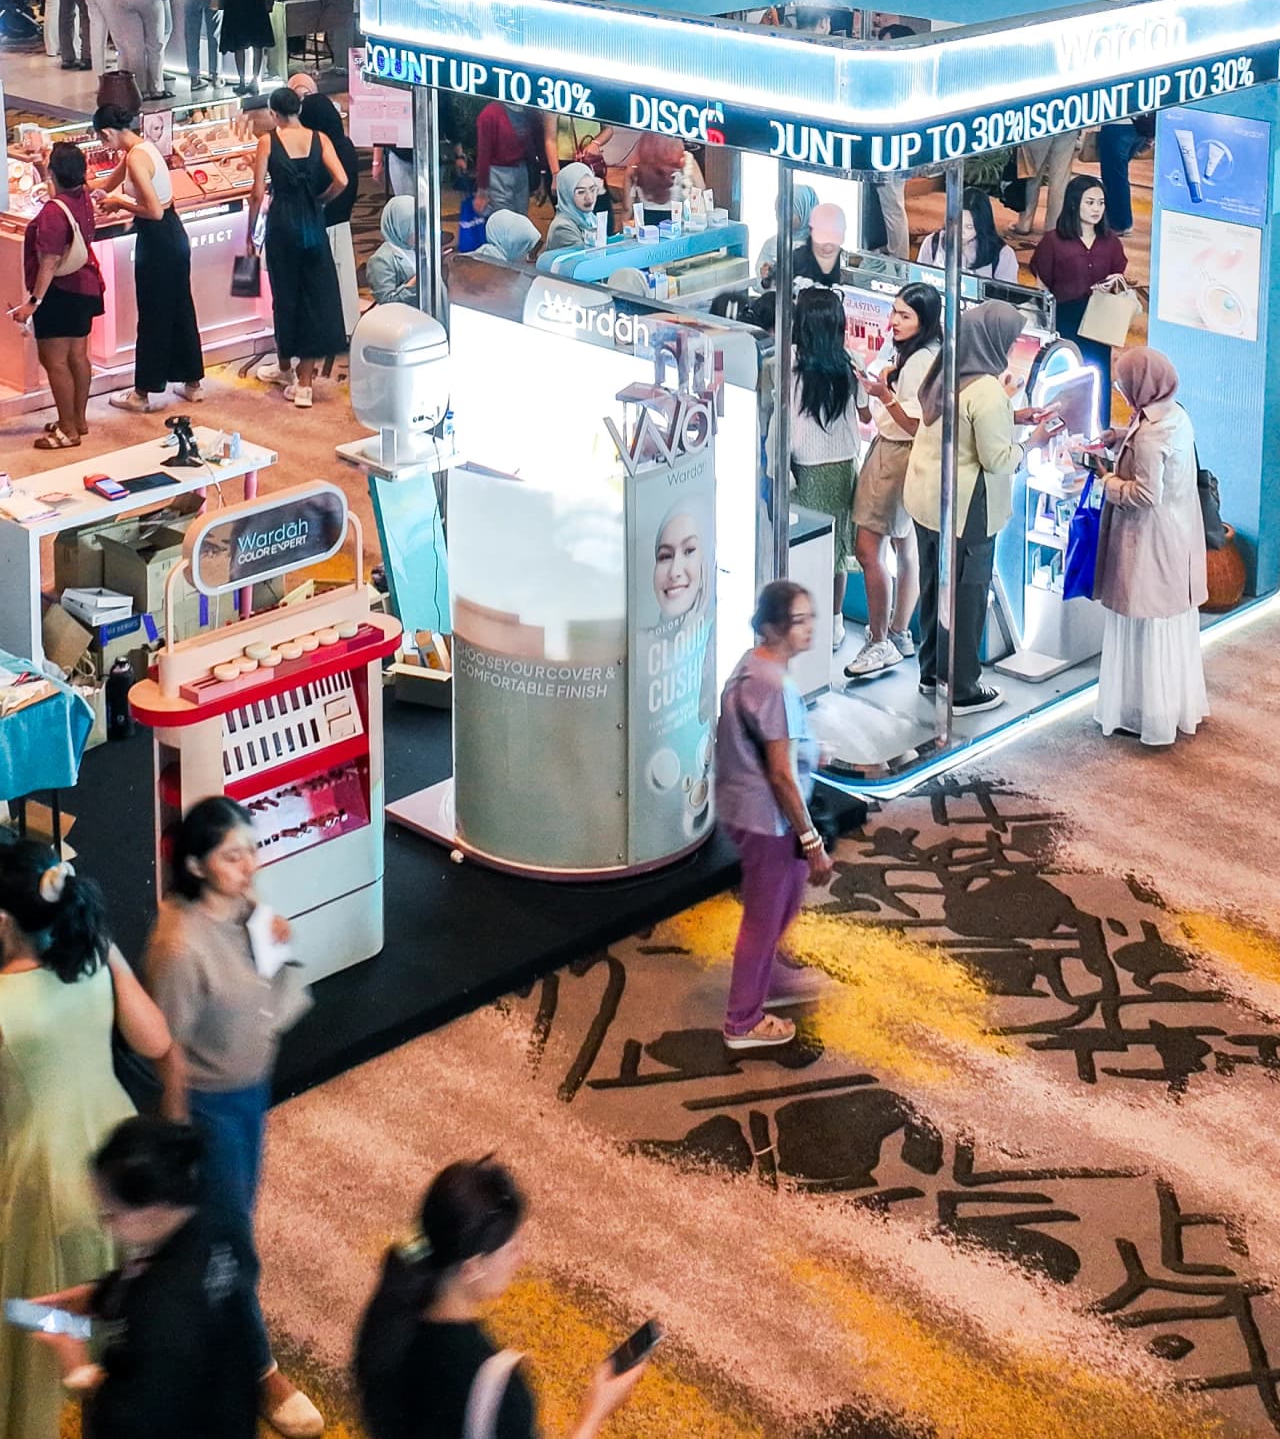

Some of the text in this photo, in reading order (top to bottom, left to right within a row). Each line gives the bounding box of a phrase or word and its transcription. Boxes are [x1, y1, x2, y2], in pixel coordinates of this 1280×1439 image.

[449, 59, 488, 95] UP
[492, 66, 531, 105] TO
[537, 76, 596, 117] 30%
[1137, 75, 1171, 111] UP
[1175, 66, 1207, 104] TO
[1210, 56, 1254, 96] 30%
[870, 131, 921, 171] UP
[927, 119, 966, 158] TO
[238, 535, 308, 565] COLOR EXPERT
[459, 660, 608, 699] COMFORTABLE FINISH
[546, 666, 602, 681] COVER
[605, 666, 617, 680] &
